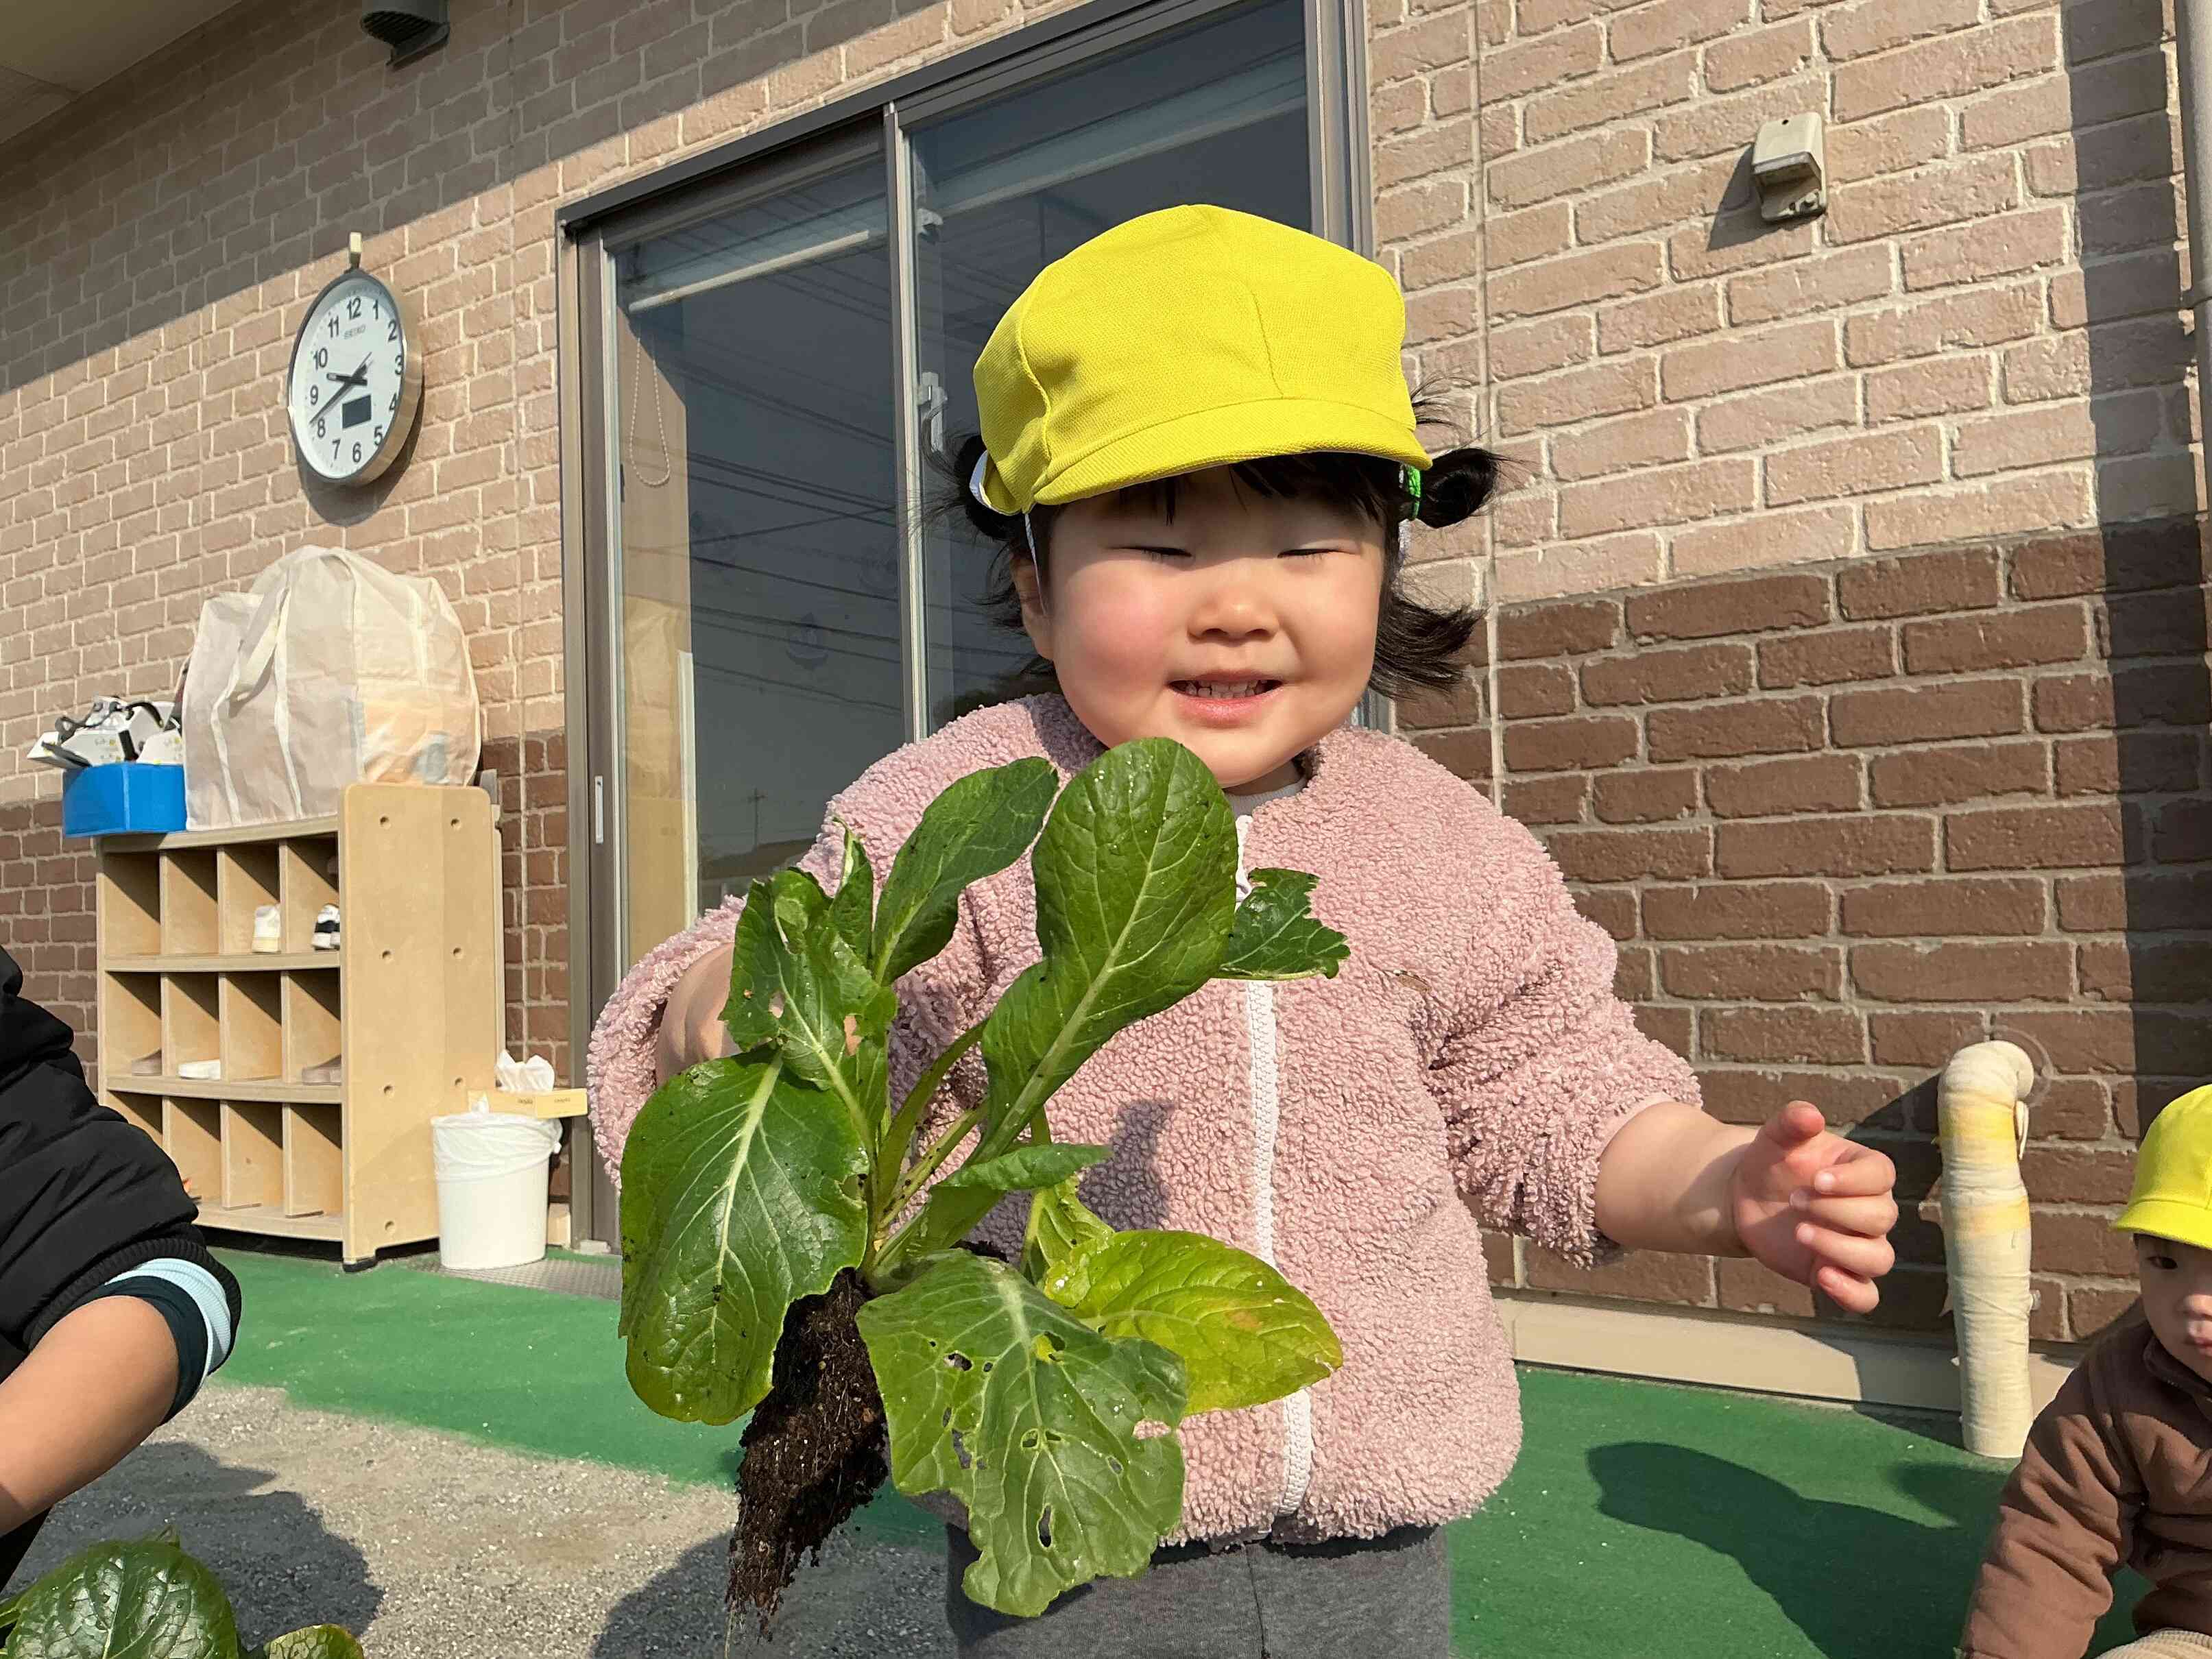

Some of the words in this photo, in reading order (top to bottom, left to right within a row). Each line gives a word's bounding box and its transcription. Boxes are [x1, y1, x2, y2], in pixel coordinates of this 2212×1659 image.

[347, 297, 361, 320] 12
[372, 300, 378, 319] 1
[328, 316, 339, 338] 11
[387, 319, 398, 342] 2
[313, 348, 328, 371] 10
[394, 355, 403, 375] 3
[310, 385, 319, 406] 9
[389, 393, 397, 411] 4
[317, 417, 326, 439] 8
[374, 425, 383, 446] 5
[332, 438, 341, 460] 7
[352, 441, 362, 463] 6
